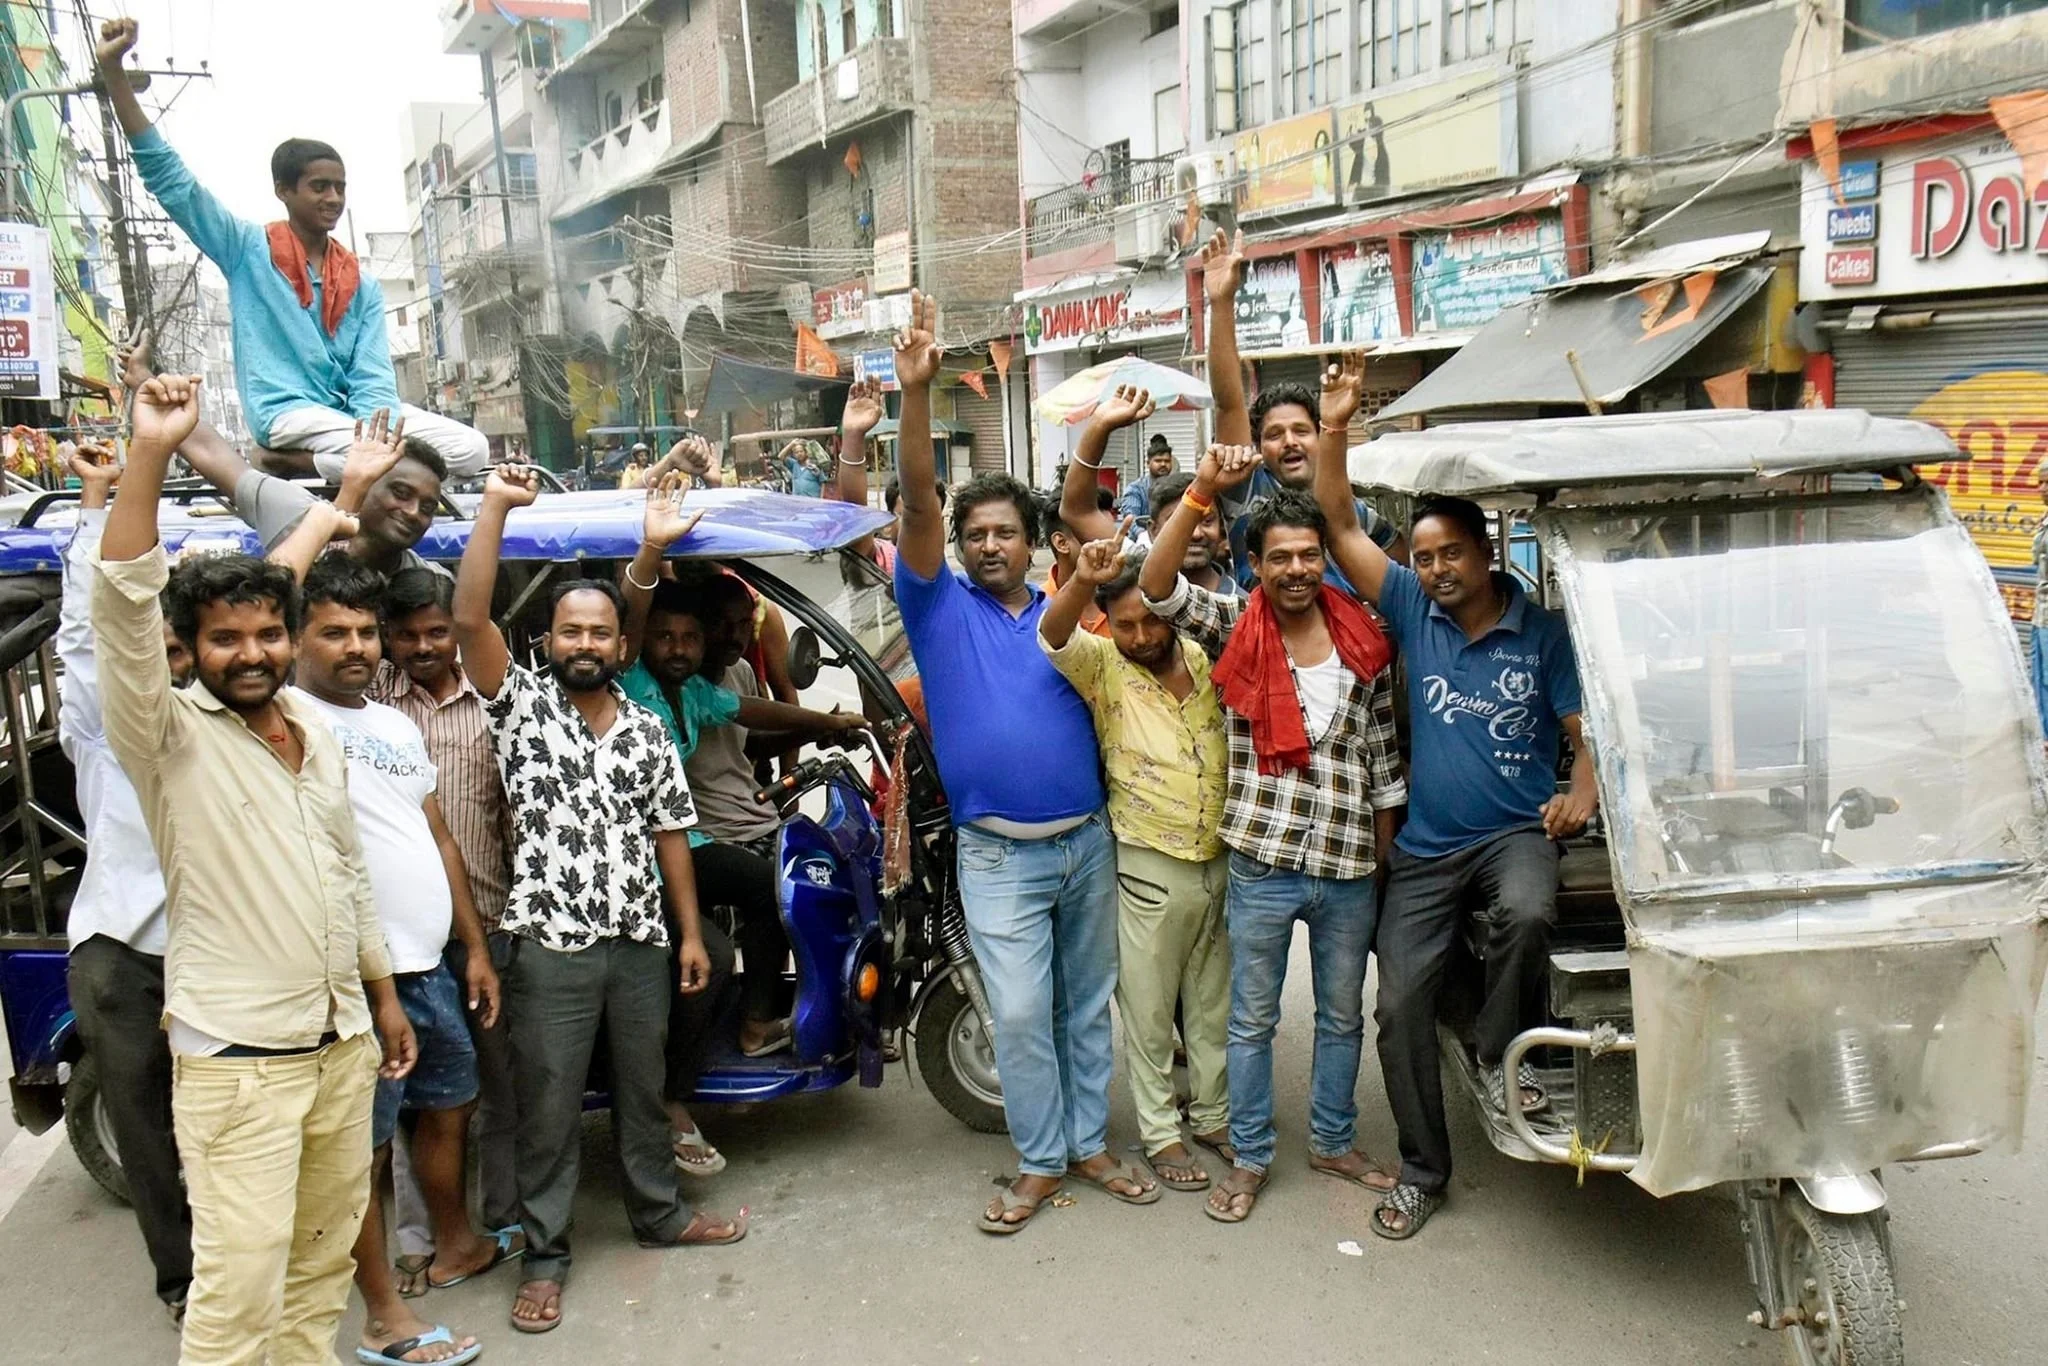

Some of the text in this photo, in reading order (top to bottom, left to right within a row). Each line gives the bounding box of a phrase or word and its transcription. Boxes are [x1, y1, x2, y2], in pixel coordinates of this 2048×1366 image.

[1829, 209, 1872, 236] Sweets
[1828, 253, 1870, 279] Cakes
[1422, 675, 1499, 724] Denim
[1499, 764, 1521, 777] 1878
